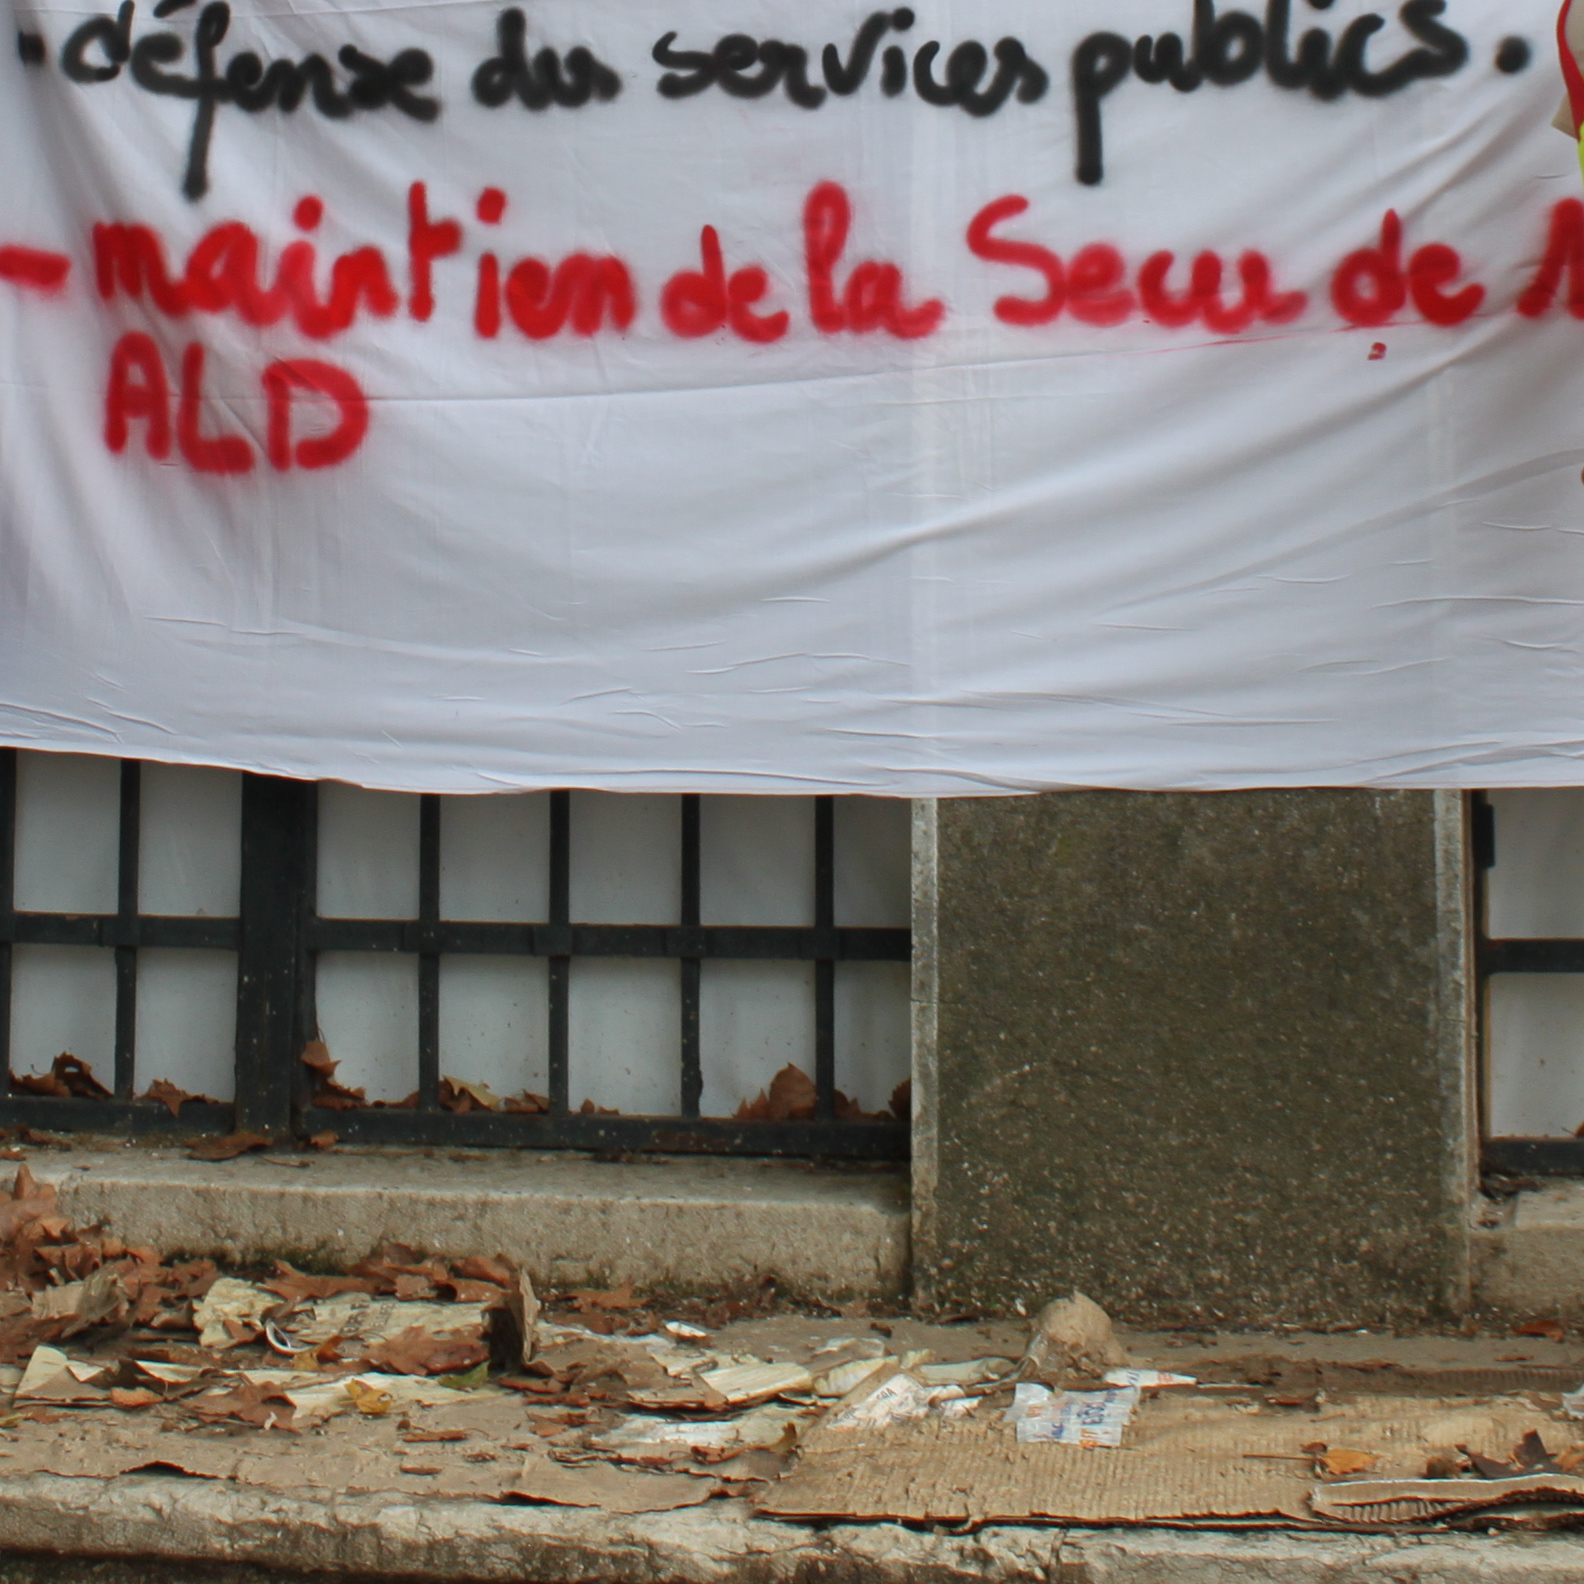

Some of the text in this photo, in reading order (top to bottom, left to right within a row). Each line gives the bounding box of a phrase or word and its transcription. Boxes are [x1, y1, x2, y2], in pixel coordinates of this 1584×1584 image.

[651, 4, 1050, 118] services
[92, 180, 638, 342] maintien
[659, 224, 790, 344] de
[802, 181, 946, 341] la
[1330, 208, 1486, 328] de
[101, 330, 370, 476] ALD
